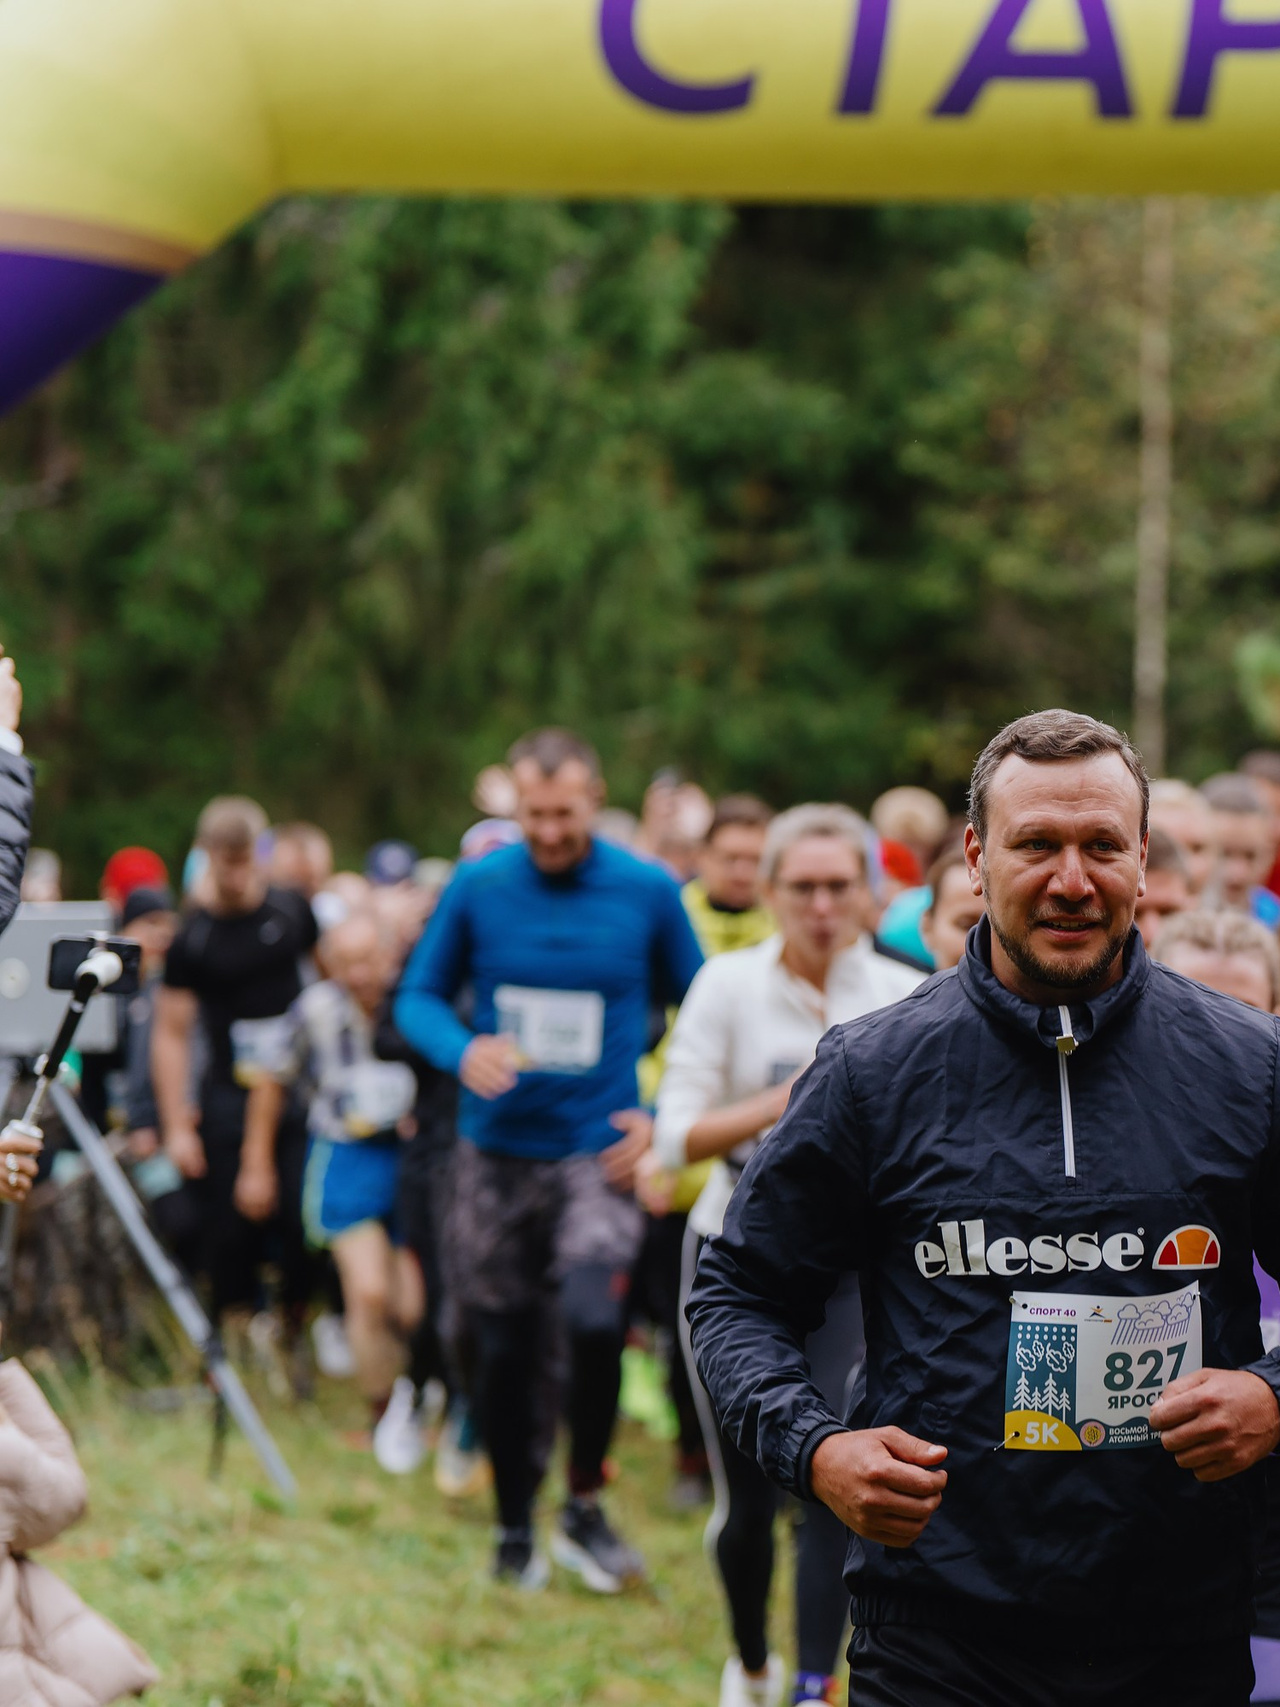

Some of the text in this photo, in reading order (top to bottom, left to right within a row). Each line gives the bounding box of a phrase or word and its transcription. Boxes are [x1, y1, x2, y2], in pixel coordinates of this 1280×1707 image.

[914, 1218, 1144, 1279] ellesse
[1029, 1307, 1062, 1317] СПОРТ
[1063, 1309, 1077, 1318] 40
[1103, 1341, 1188, 1392] 827
[1108, 1391, 1163, 1410] ЯРОС
[1109, 1424, 1149, 1435] ВОСЬМОЙ
[1108, 1432, 1149, 1444] АТОМНЫЙ
